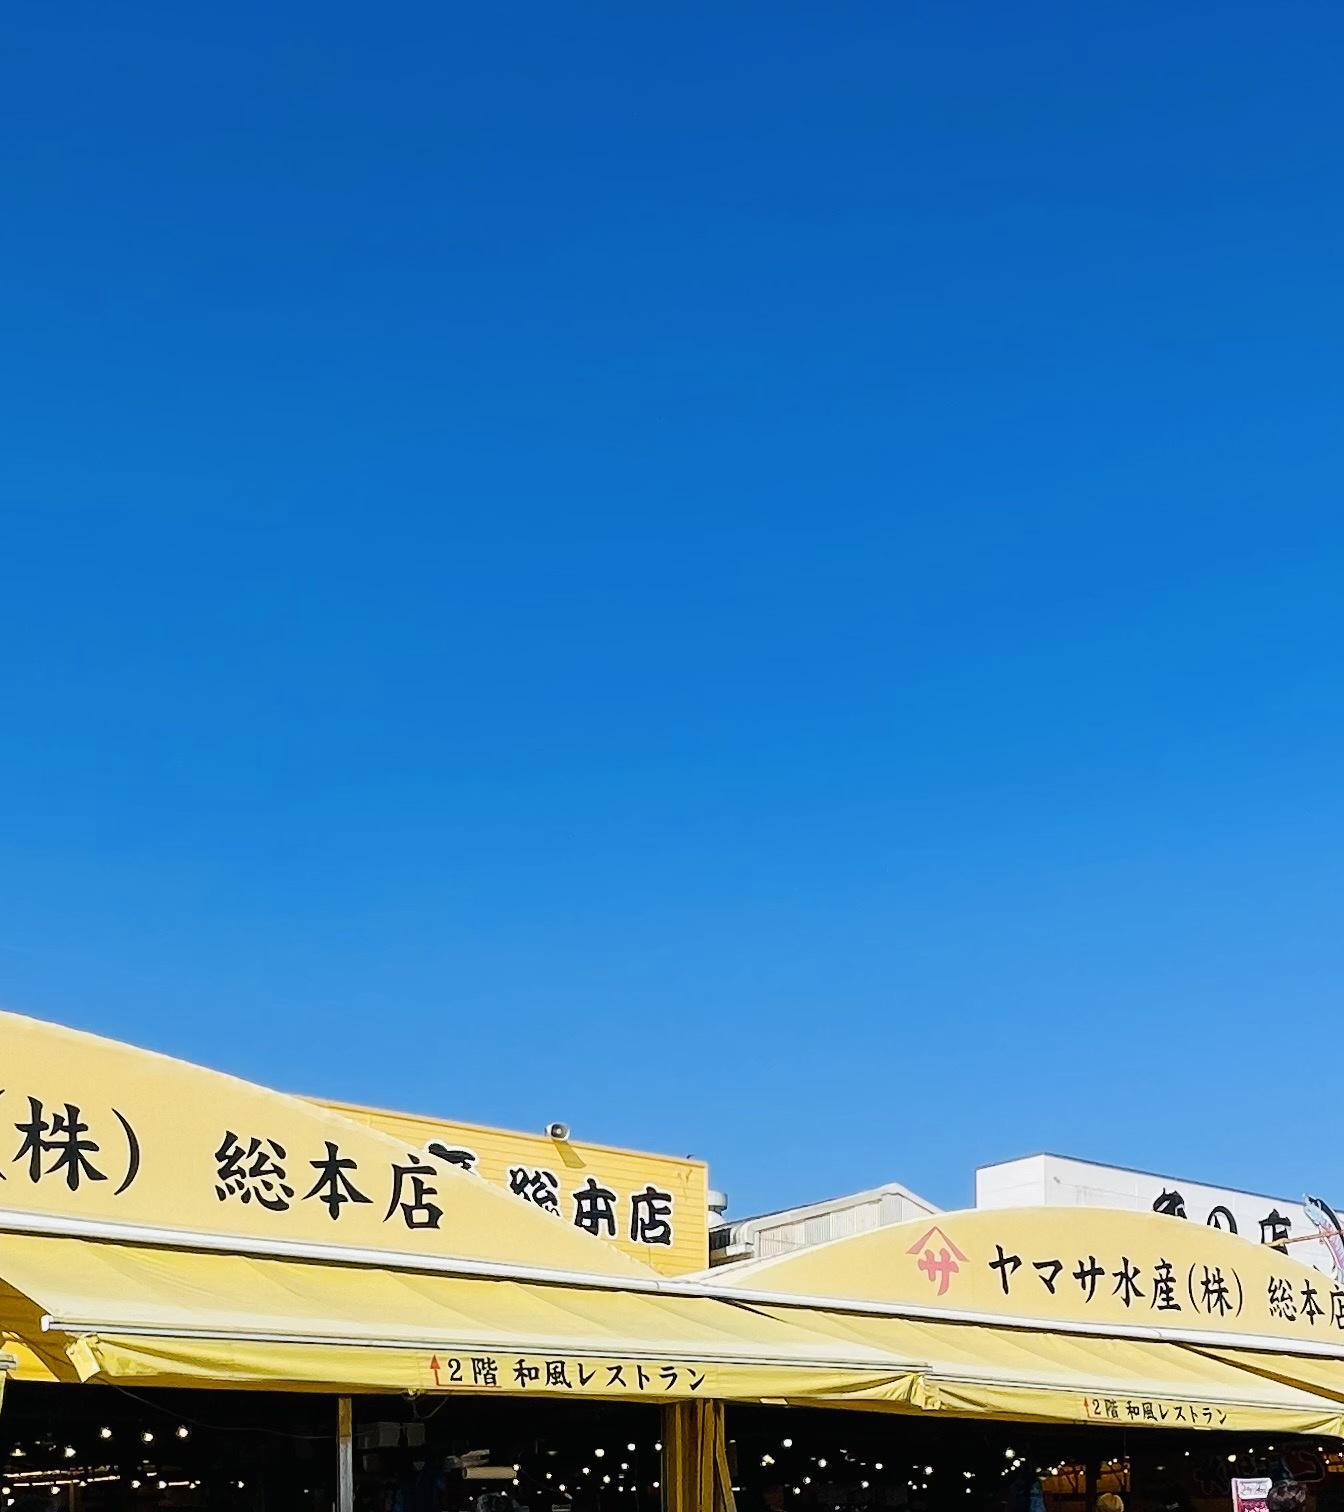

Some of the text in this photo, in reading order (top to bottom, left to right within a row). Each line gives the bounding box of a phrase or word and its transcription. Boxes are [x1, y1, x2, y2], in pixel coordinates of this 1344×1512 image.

[213, 1130, 442, 1231] 総本店
[988, 1244, 1243, 1318] ヤマサ水産(株)
[447, 1356, 707, 1391] 2階 和風レストラン
[1092, 1398, 1227, 1425] 2階 和風レストラン
